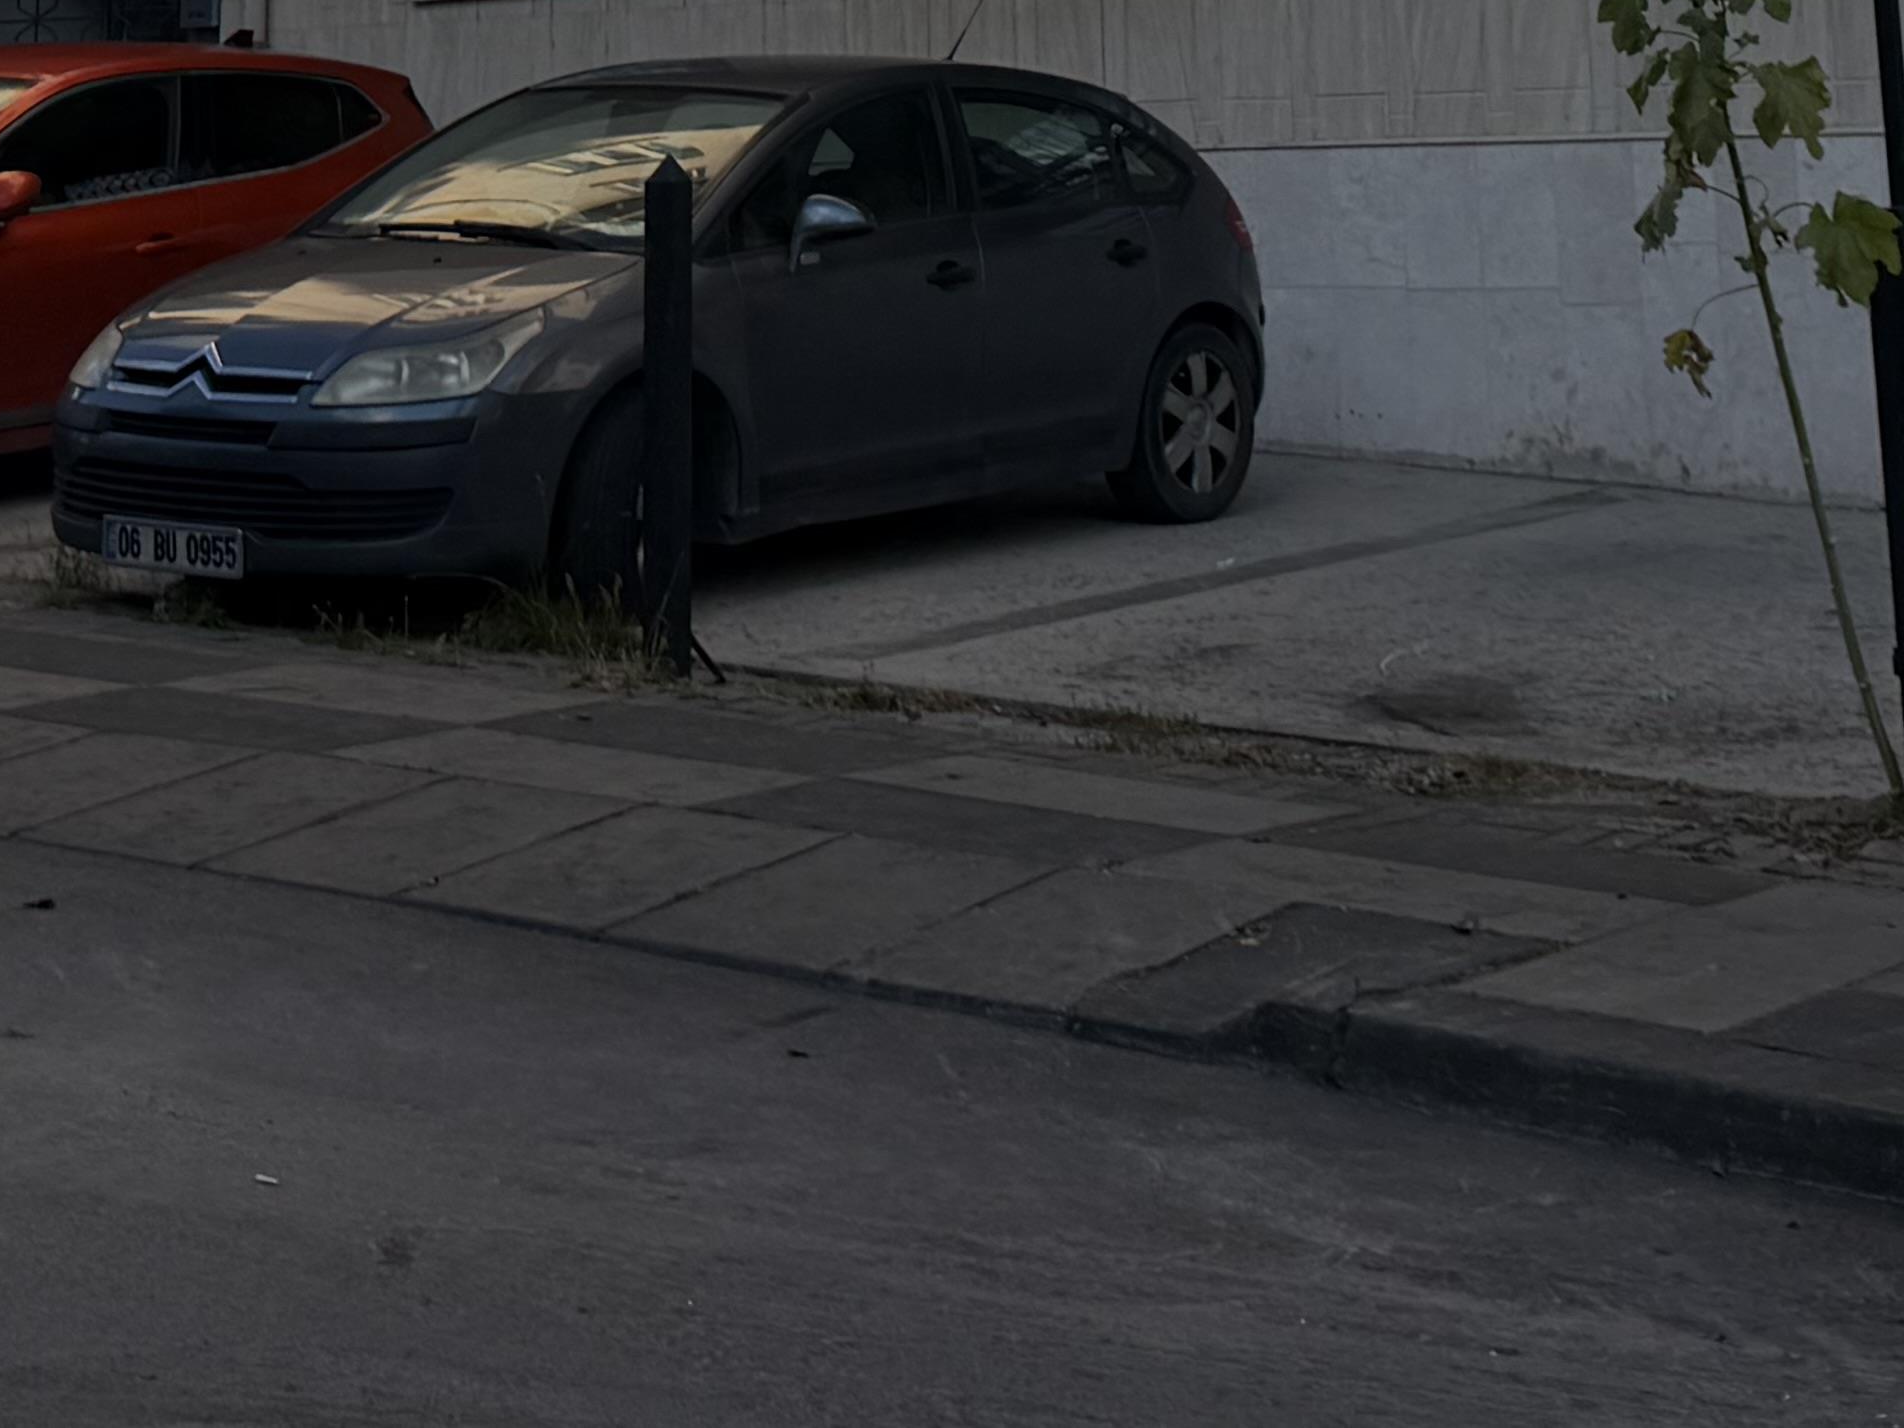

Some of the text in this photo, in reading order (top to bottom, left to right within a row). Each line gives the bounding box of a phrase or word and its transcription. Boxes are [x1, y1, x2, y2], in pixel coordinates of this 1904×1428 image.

[119, 526, 236, 568] 06 BU 0955
